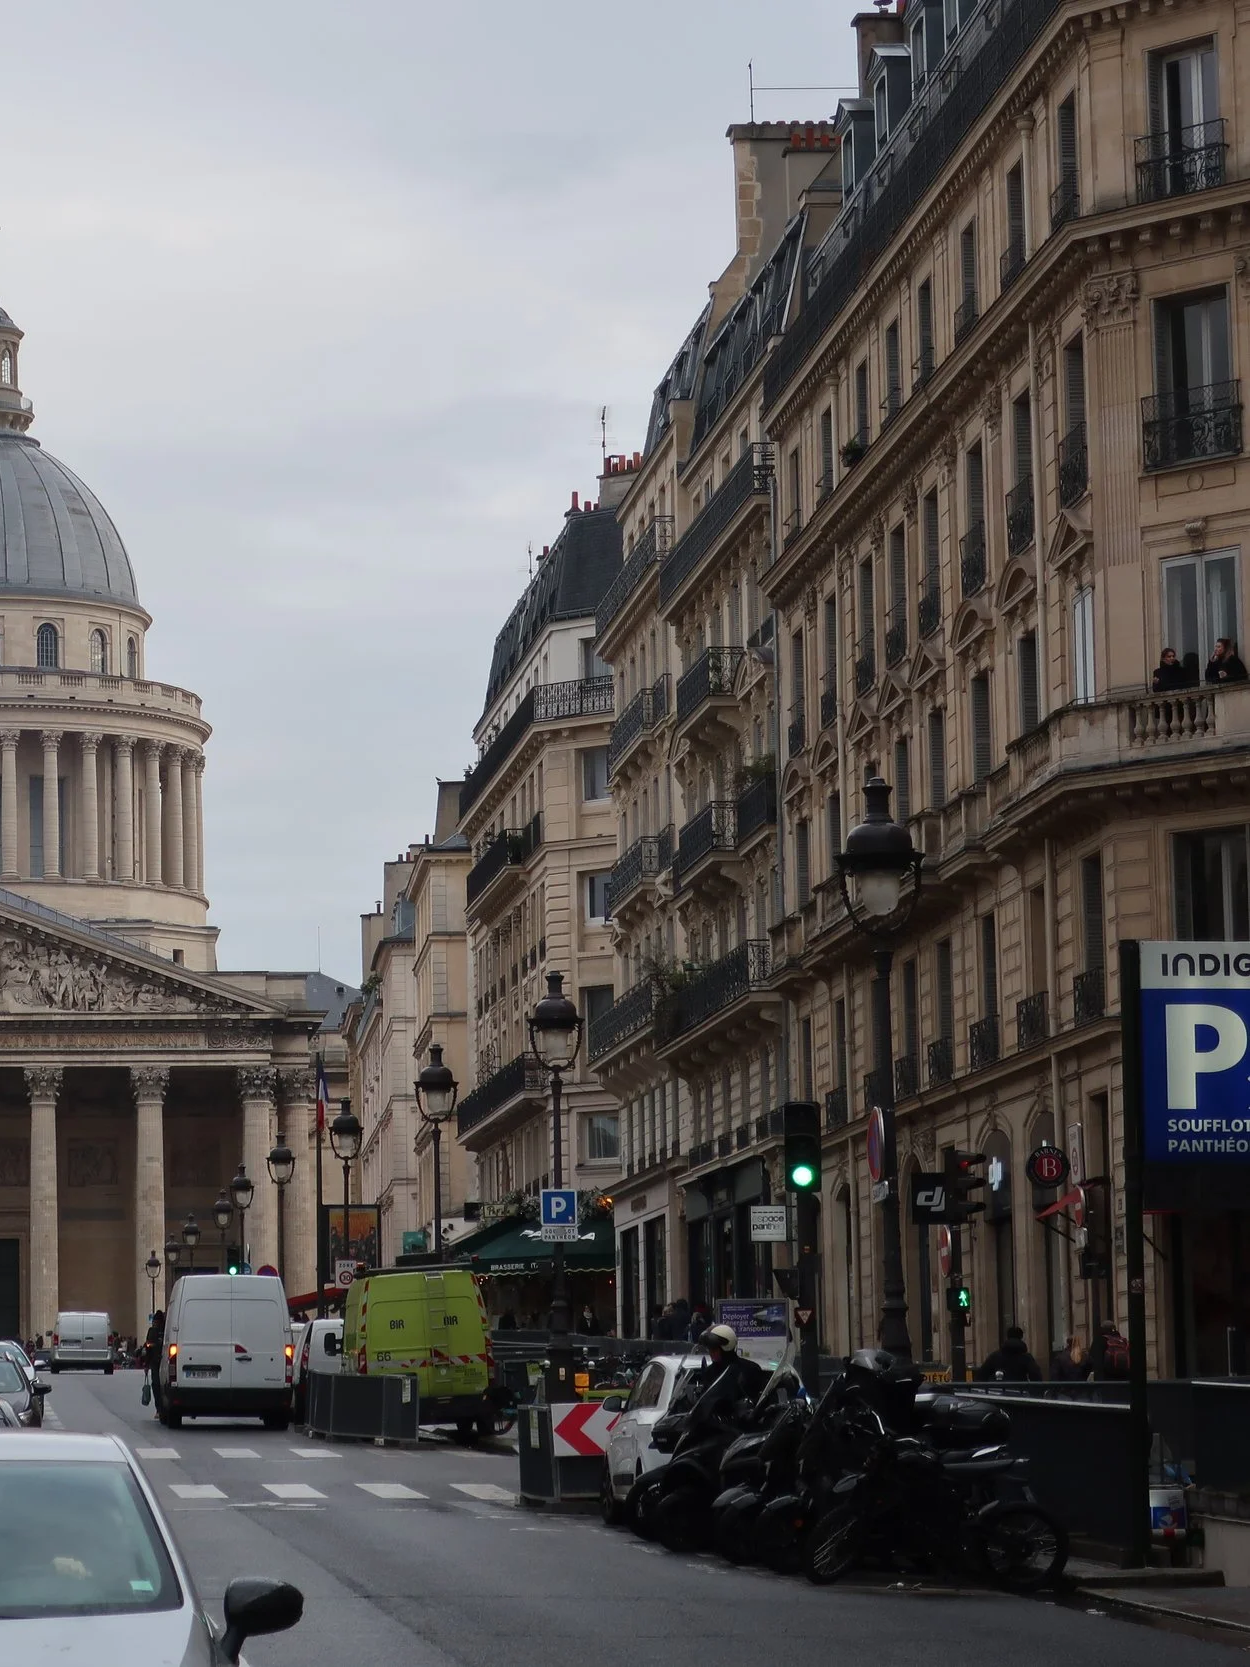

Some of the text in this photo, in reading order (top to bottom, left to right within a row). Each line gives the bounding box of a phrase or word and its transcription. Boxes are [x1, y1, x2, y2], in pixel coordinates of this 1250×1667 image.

[1161, 953, 1250, 976] INDIG
[1165, 1004, 1247, 1110] P
[1168, 1119, 1250, 1132] SOUFFLOT
[1168, 1136, 1250, 1152] PANTHÉO
[1035, 1147, 1062, 1158] BARNES
[551, 1197, 567, 1218] P
[490, 1263, 525, 1271] BRASSERIE
[376, 1351, 391, 1362] 66
